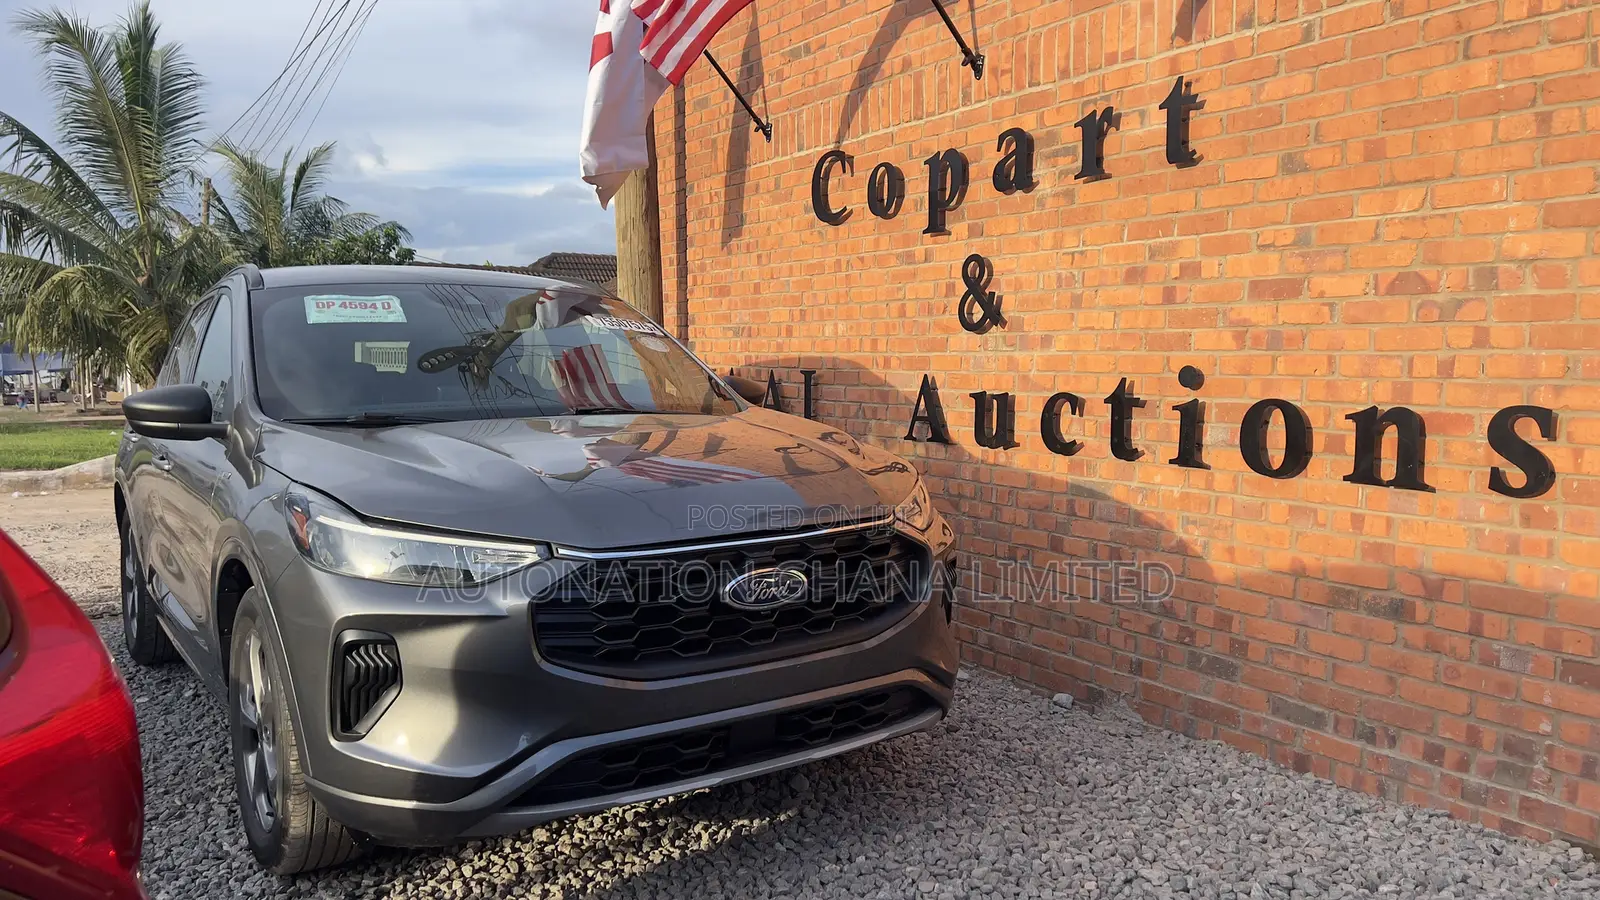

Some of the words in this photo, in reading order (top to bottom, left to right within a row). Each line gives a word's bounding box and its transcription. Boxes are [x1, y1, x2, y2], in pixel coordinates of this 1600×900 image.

[811, 76, 1204, 235] Copart
[316, 301, 336, 309] DP
[338, 301, 378, 310] 4594
[958, 253, 1004, 334] &
[903, 366, 1558, 498] Auctions
[746, 577, 790, 600] Ford
